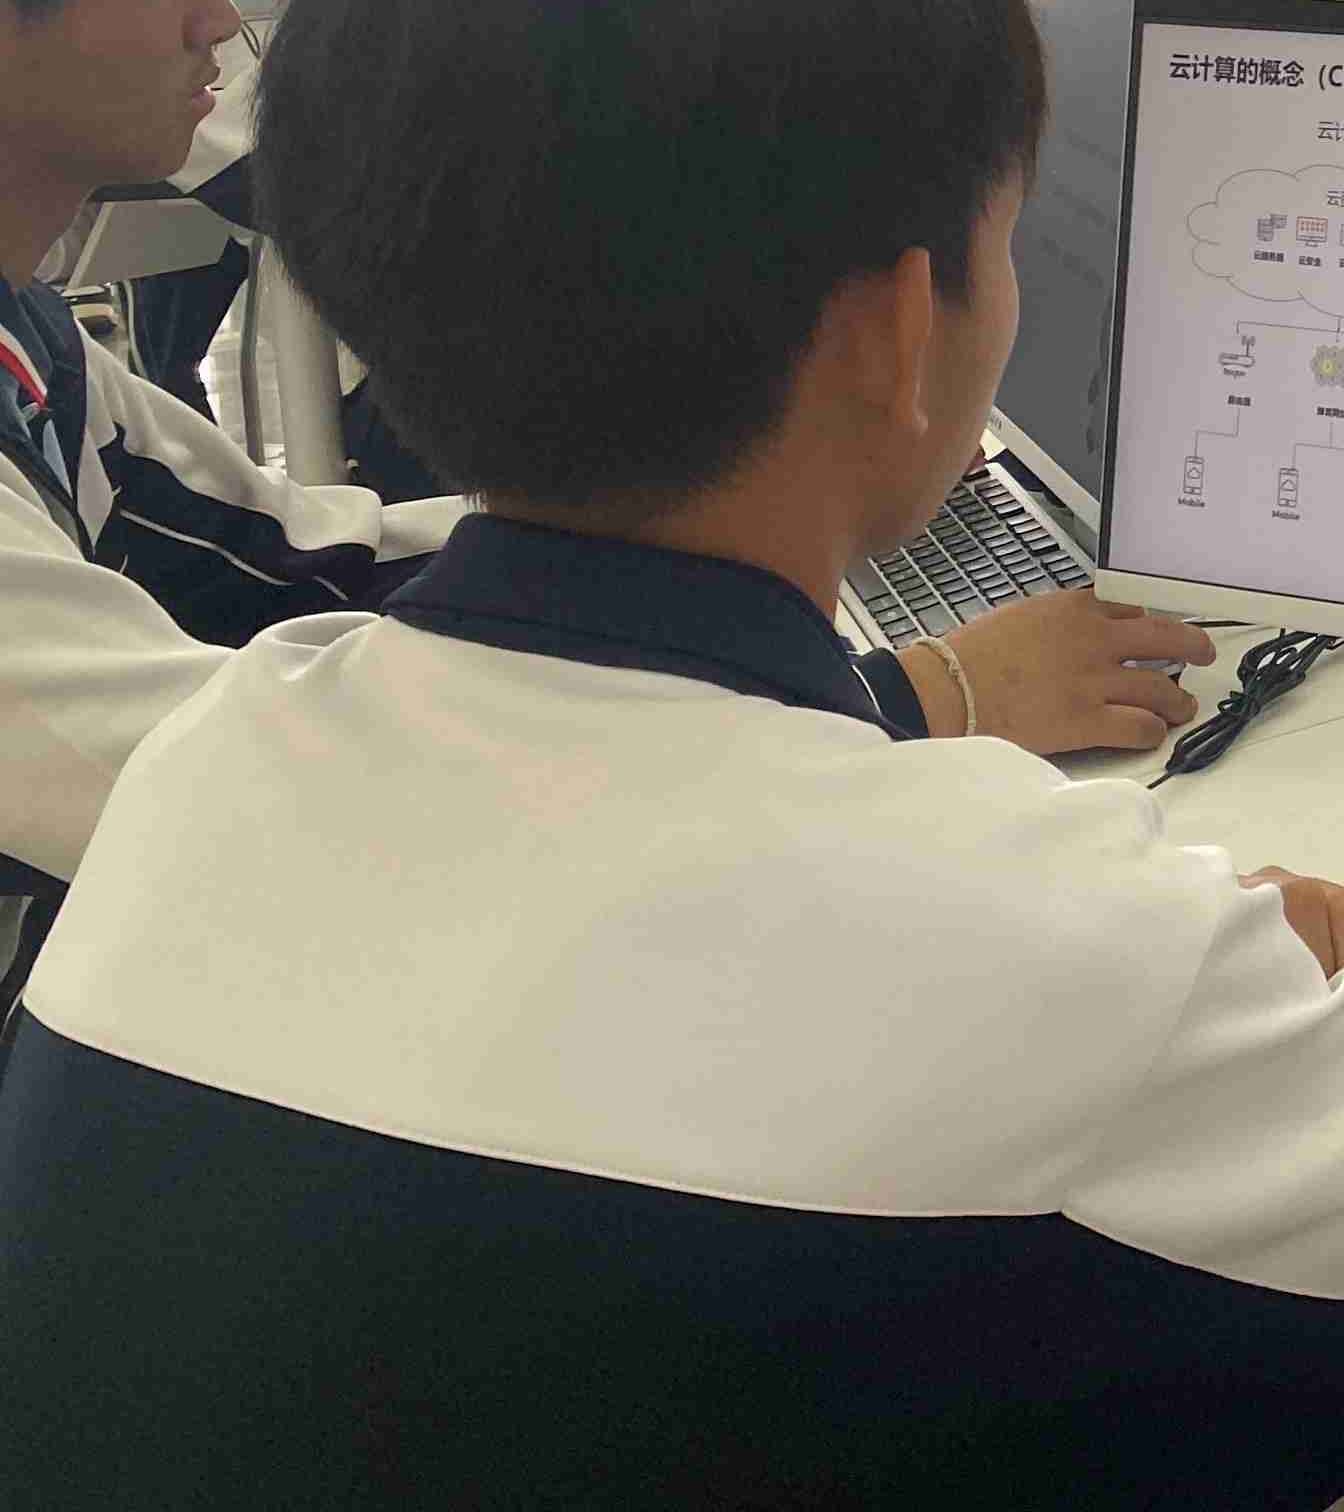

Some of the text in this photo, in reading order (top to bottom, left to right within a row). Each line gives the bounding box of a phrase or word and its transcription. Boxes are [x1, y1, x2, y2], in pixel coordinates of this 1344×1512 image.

[1168, 54, 1305, 87] 云计算的概念
